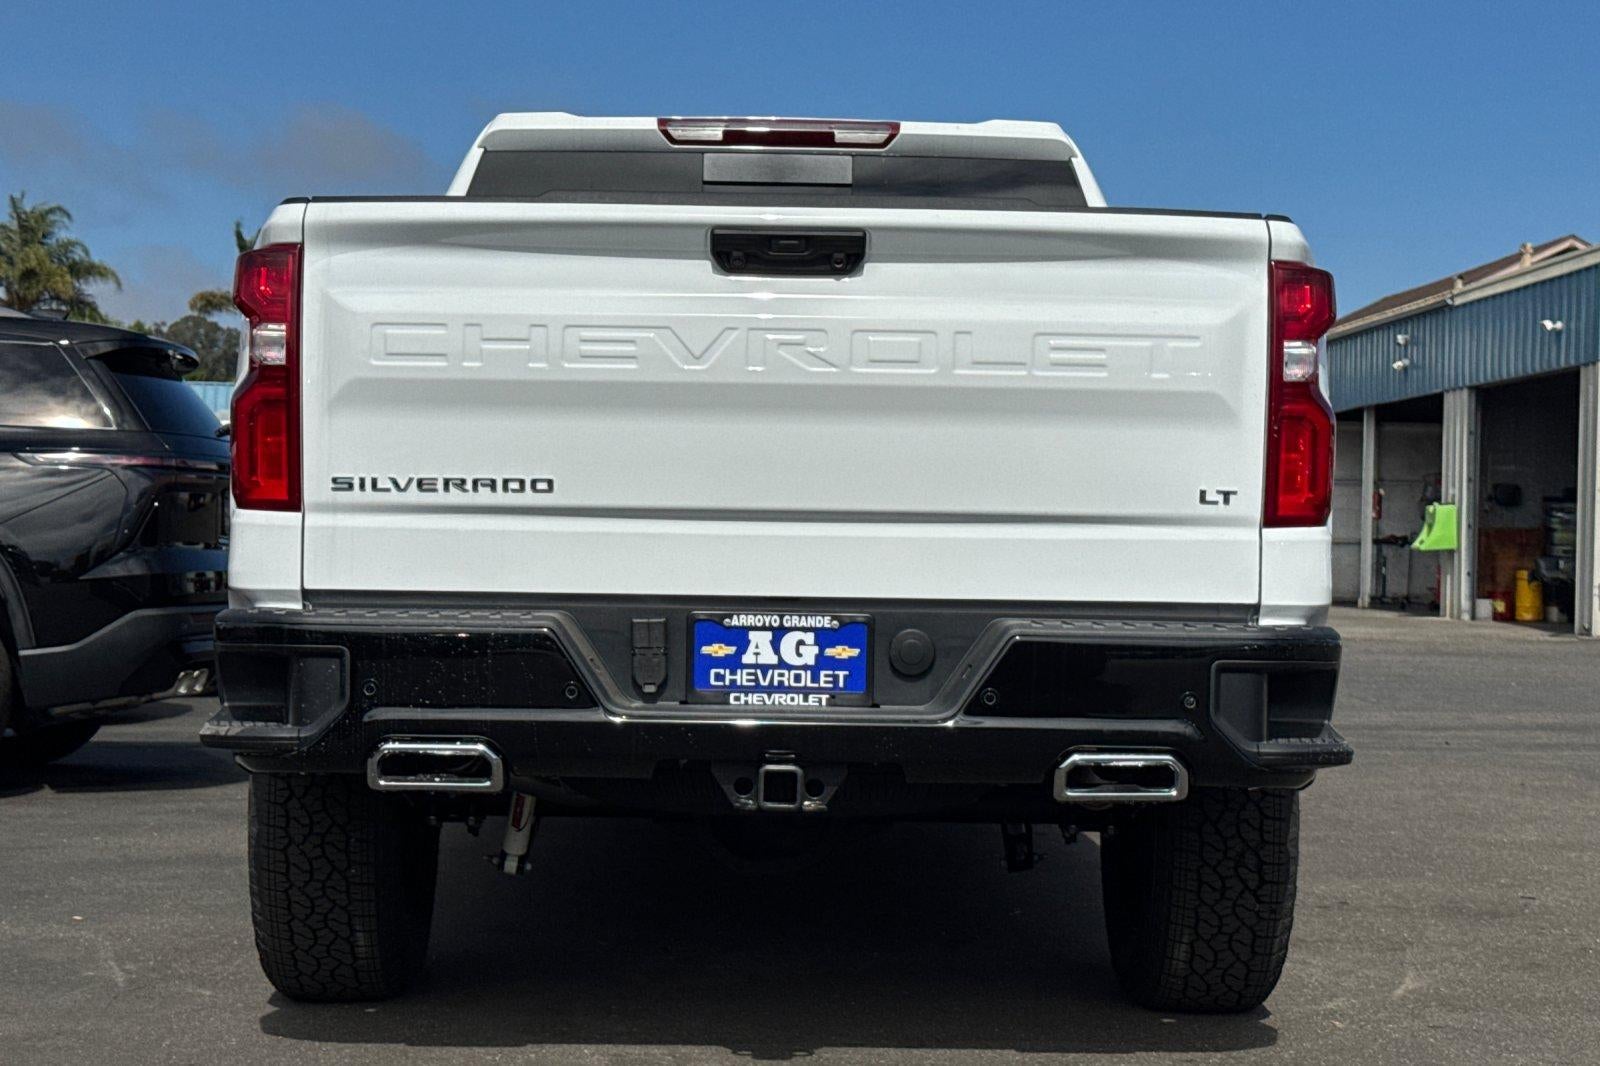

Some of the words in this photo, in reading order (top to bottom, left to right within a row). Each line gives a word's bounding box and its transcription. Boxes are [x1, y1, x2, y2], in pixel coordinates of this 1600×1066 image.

[369, 322, 1202, 377] CHEVROLET
[331, 476, 555, 494] SILVERADO
[1199, 489, 1238, 506] LT
[731, 614, 780, 627] ARROYO
[782, 616, 832, 628] GRANDE
[741, 630, 819, 666] AG
[709, 668, 850, 688] CHEVROLET
[729, 692, 831, 706] CHEVROLET
